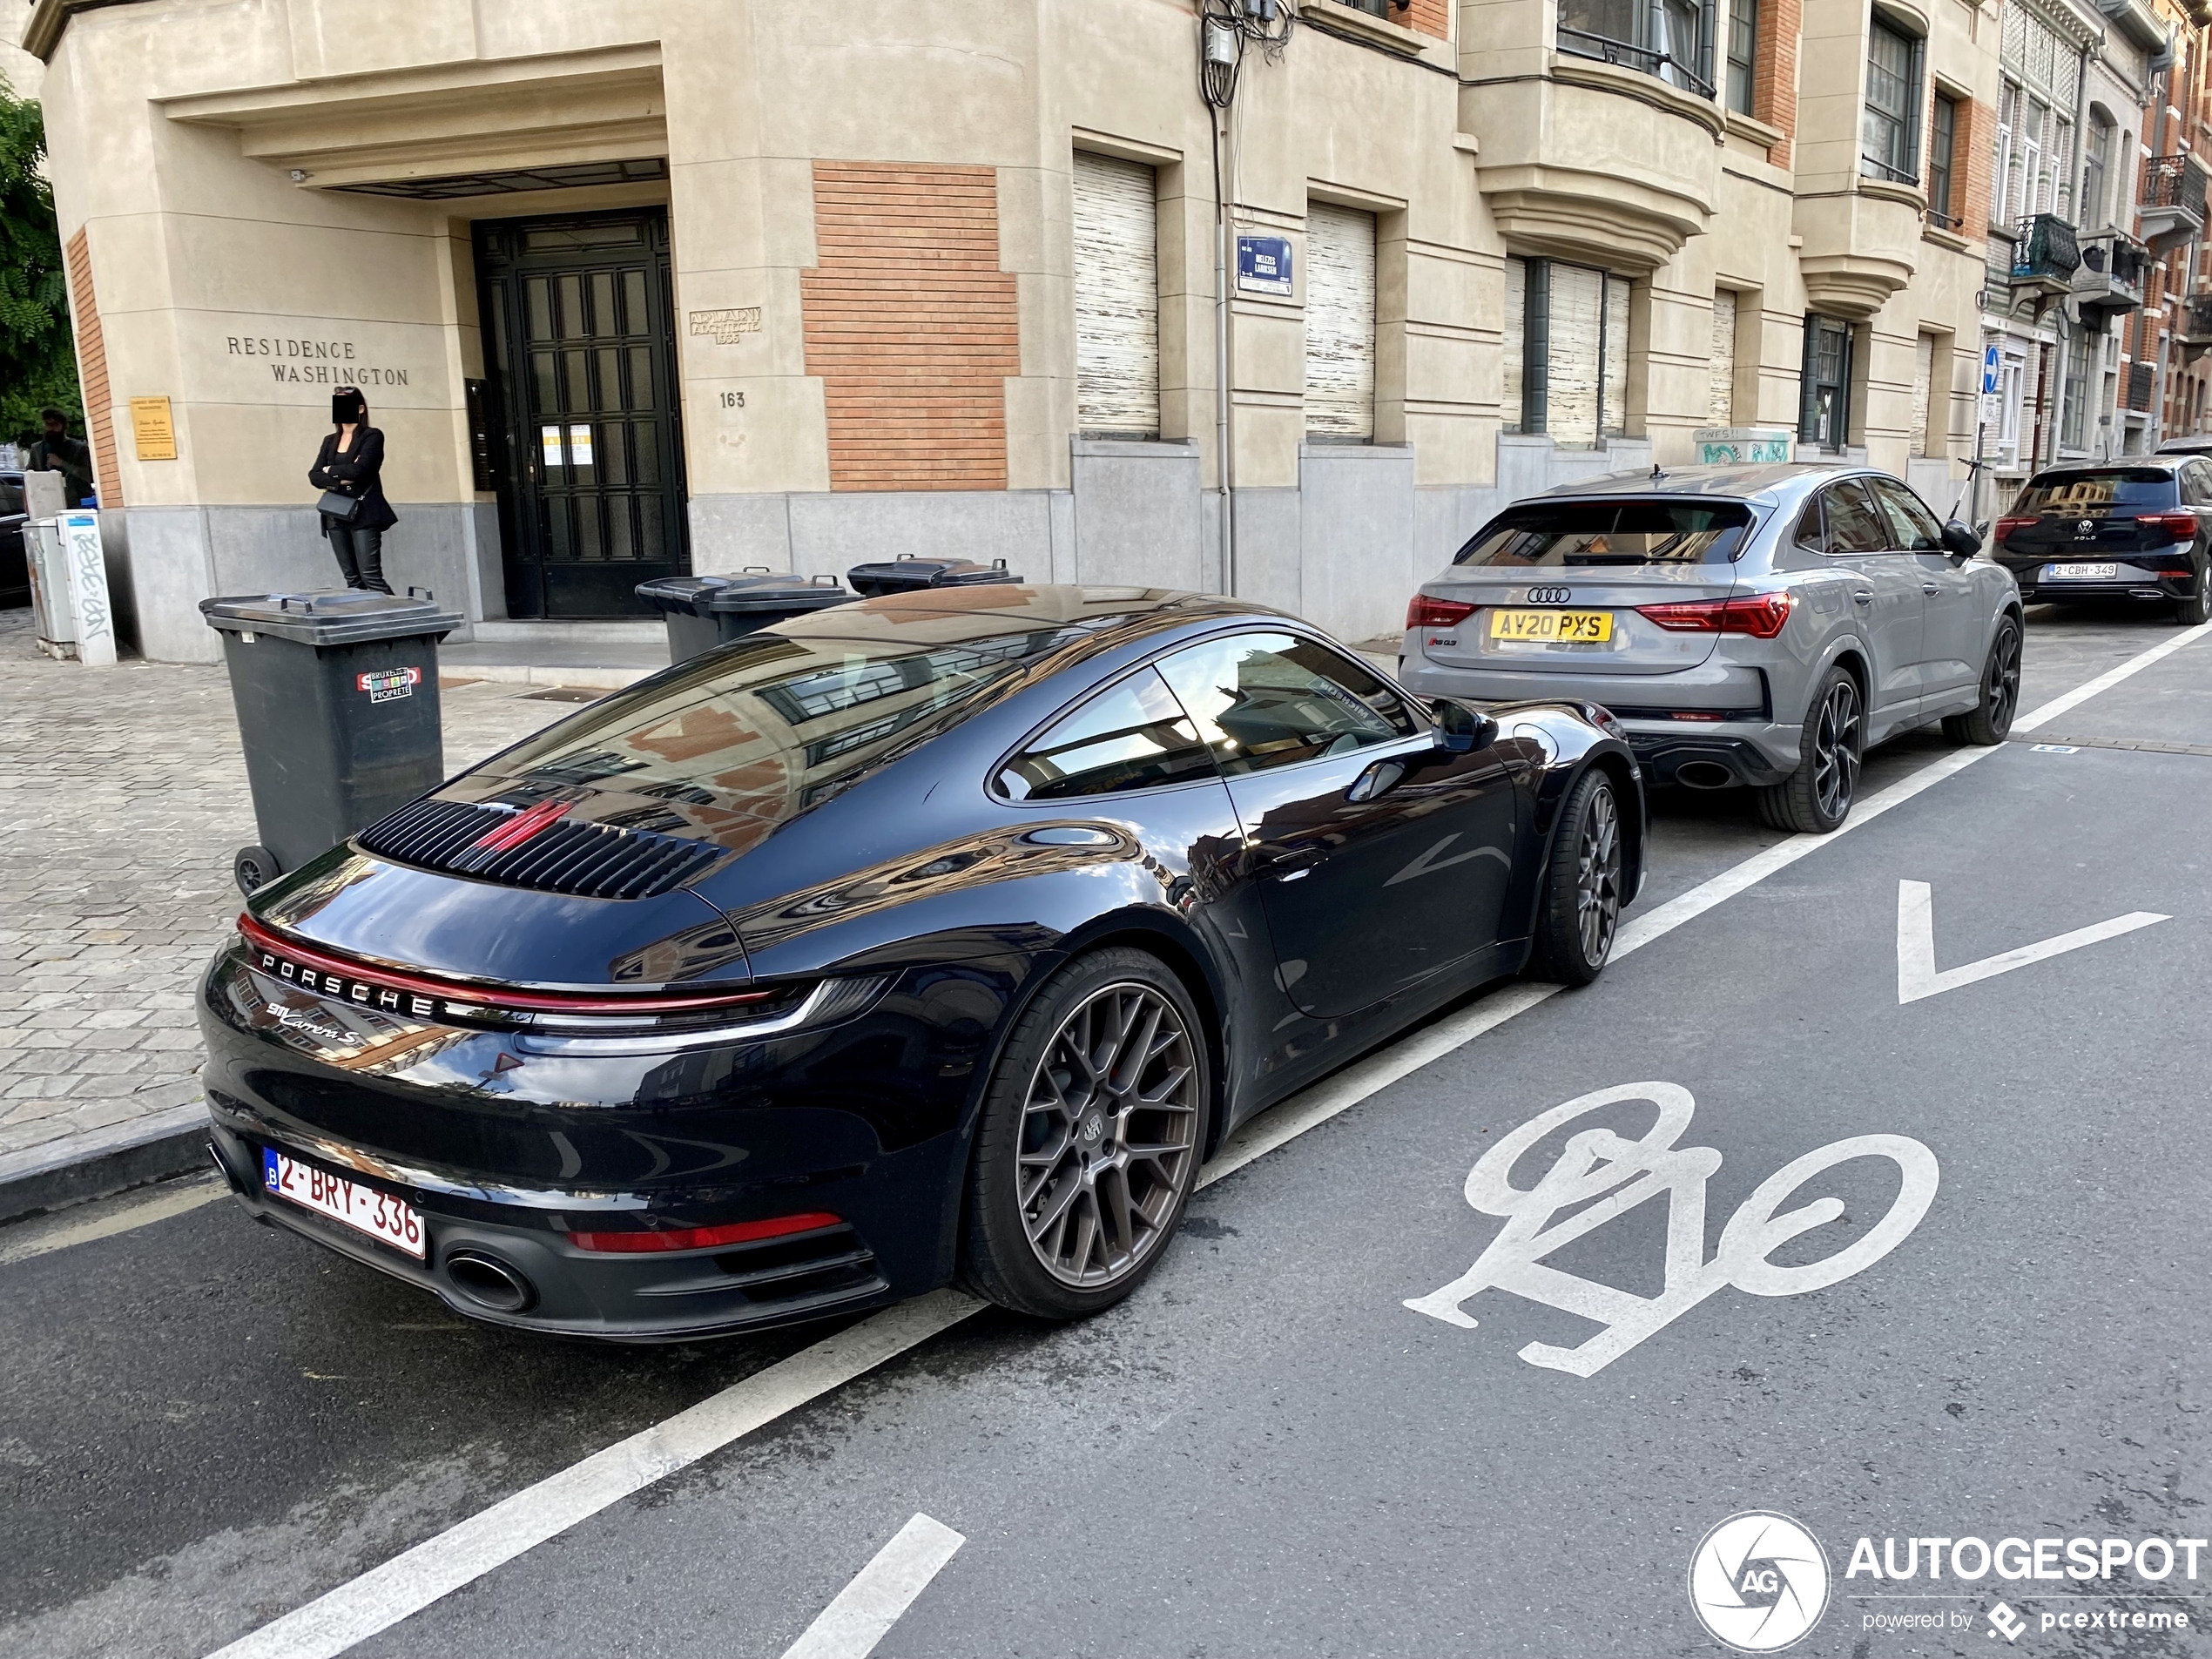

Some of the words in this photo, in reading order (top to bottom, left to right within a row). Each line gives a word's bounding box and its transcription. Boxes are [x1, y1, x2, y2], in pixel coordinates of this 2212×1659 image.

[691, 321, 761, 336] ARCHITECTE
[226, 336, 356, 360] RESIDENCE
[270, 364, 409, 386] WASHINGTON
[720, 392, 745, 408] 163
[2055, 564, 2114, 575] 2-CBH-349
[1500, 615, 1554, 636] AV20
[1558, 616, 1602, 637] PXS
[263, 954, 434, 1016] PORSCHE
[266, 1002, 290, 1018] 911
[279, 1014, 340, 1040] Carrera
[337, 1031, 360, 1044] S
[269, 1168, 278, 1186] B
